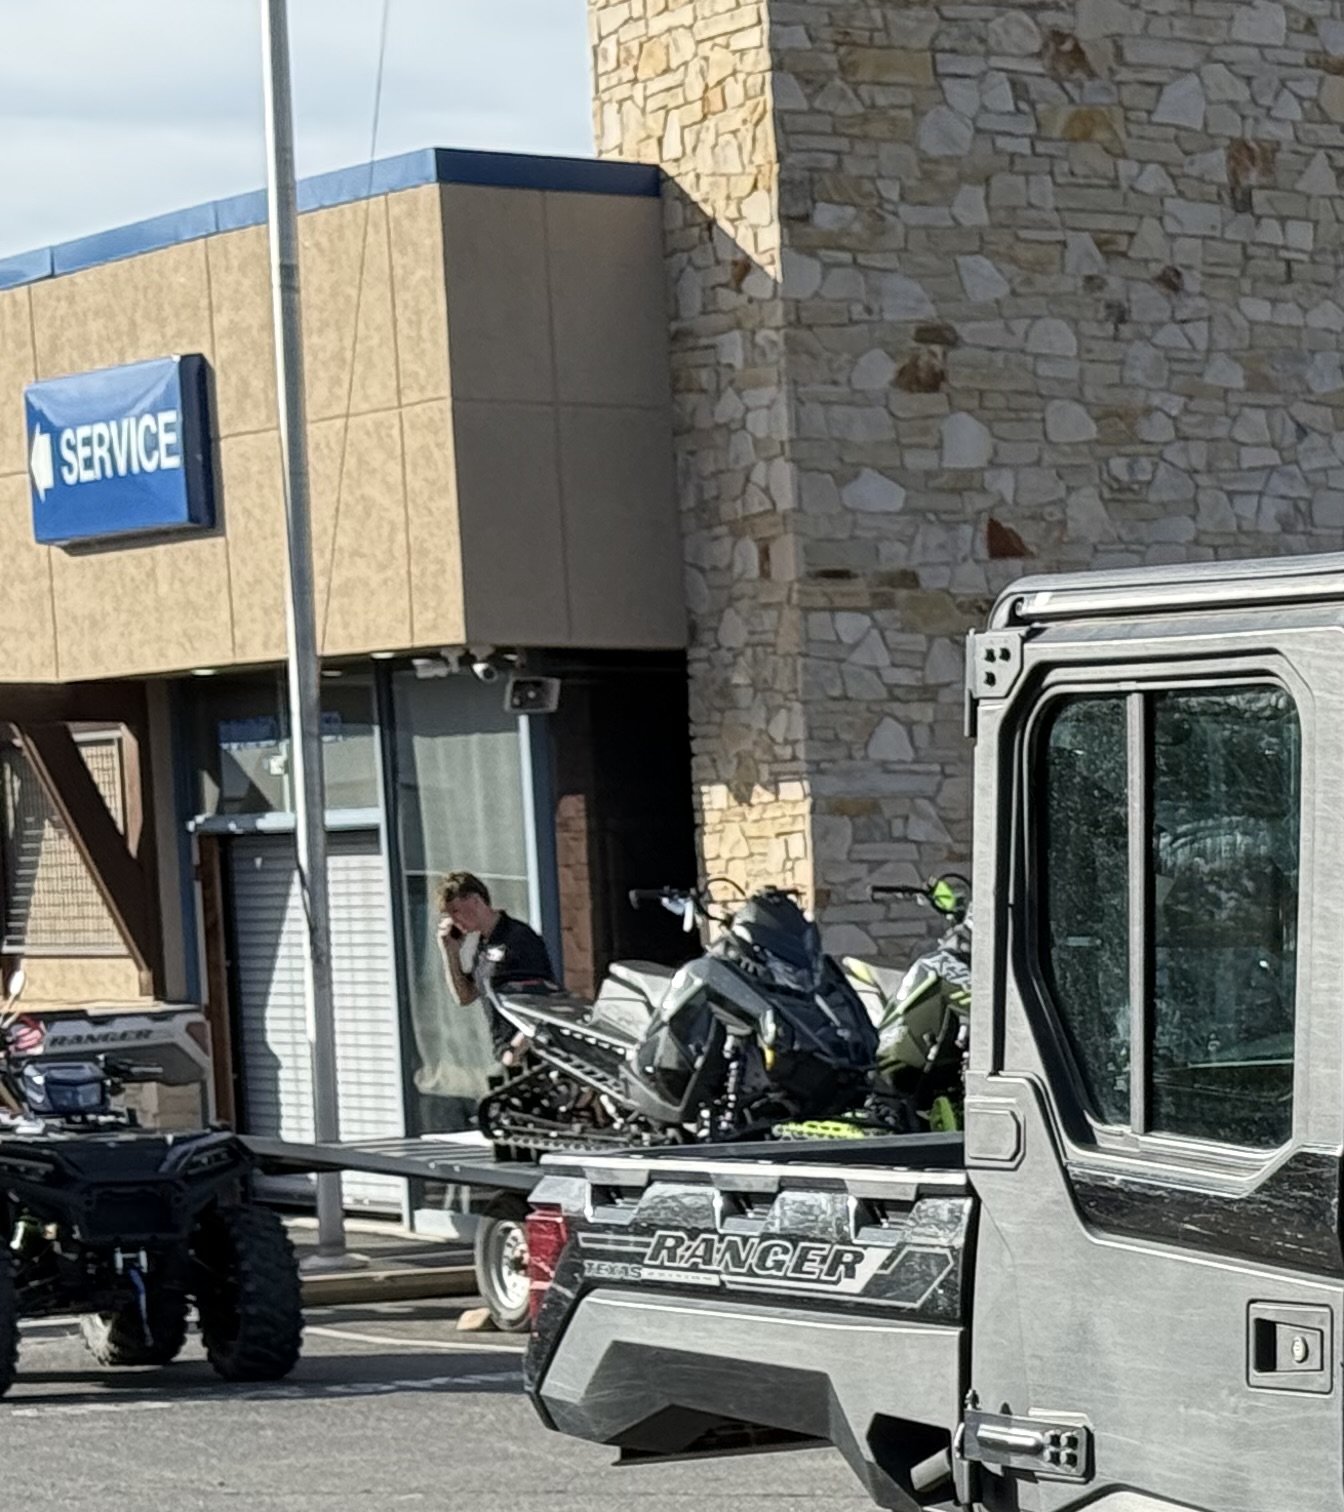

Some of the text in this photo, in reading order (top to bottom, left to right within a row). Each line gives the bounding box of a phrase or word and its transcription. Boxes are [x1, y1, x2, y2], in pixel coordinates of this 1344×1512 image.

[60, 409, 183, 486] SERVICE
[583, 1259, 642, 1280] TEXAS
[644, 1229, 867, 1281] RANGER
